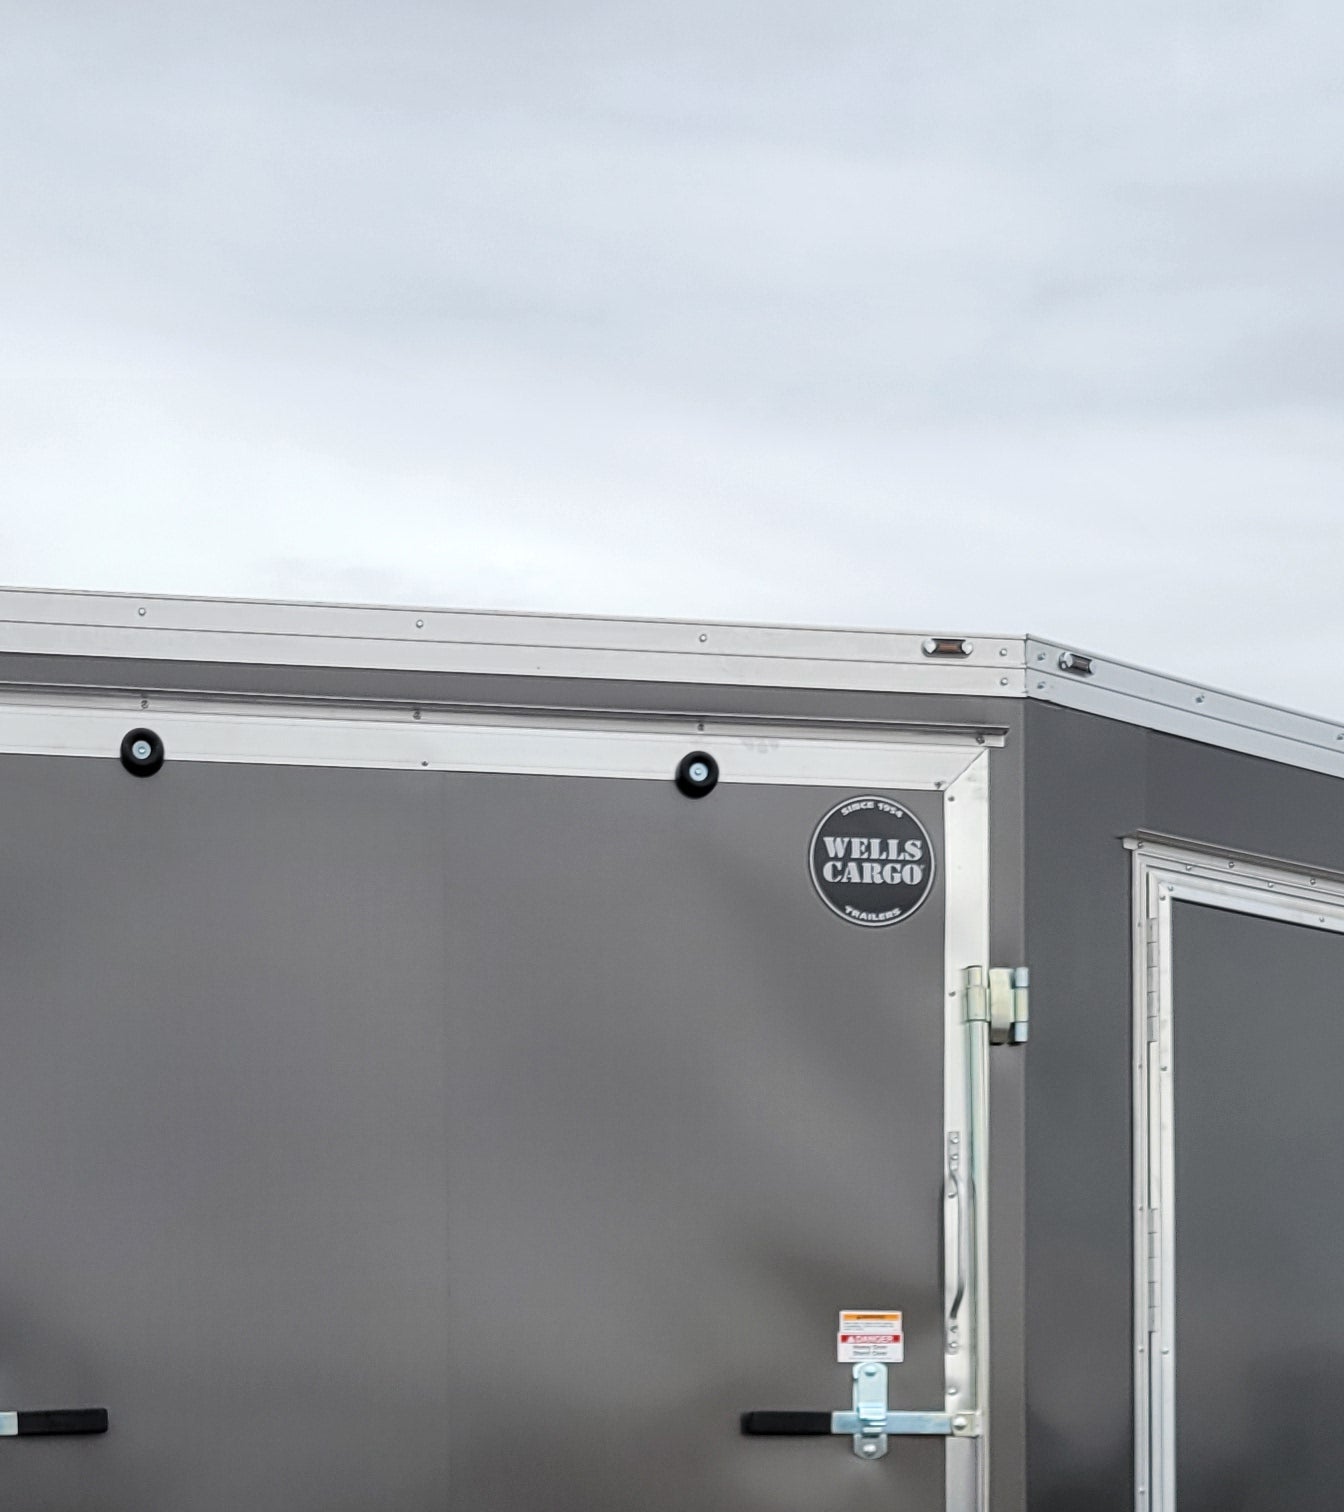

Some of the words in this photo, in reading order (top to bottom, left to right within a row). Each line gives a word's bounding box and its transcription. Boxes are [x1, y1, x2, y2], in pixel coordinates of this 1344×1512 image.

[840, 801, 875, 816] SINCE
[822, 836, 924, 861] WELLS
[822, 861, 924, 886] CARGO
[845, 905, 902, 921] TRAILERS
